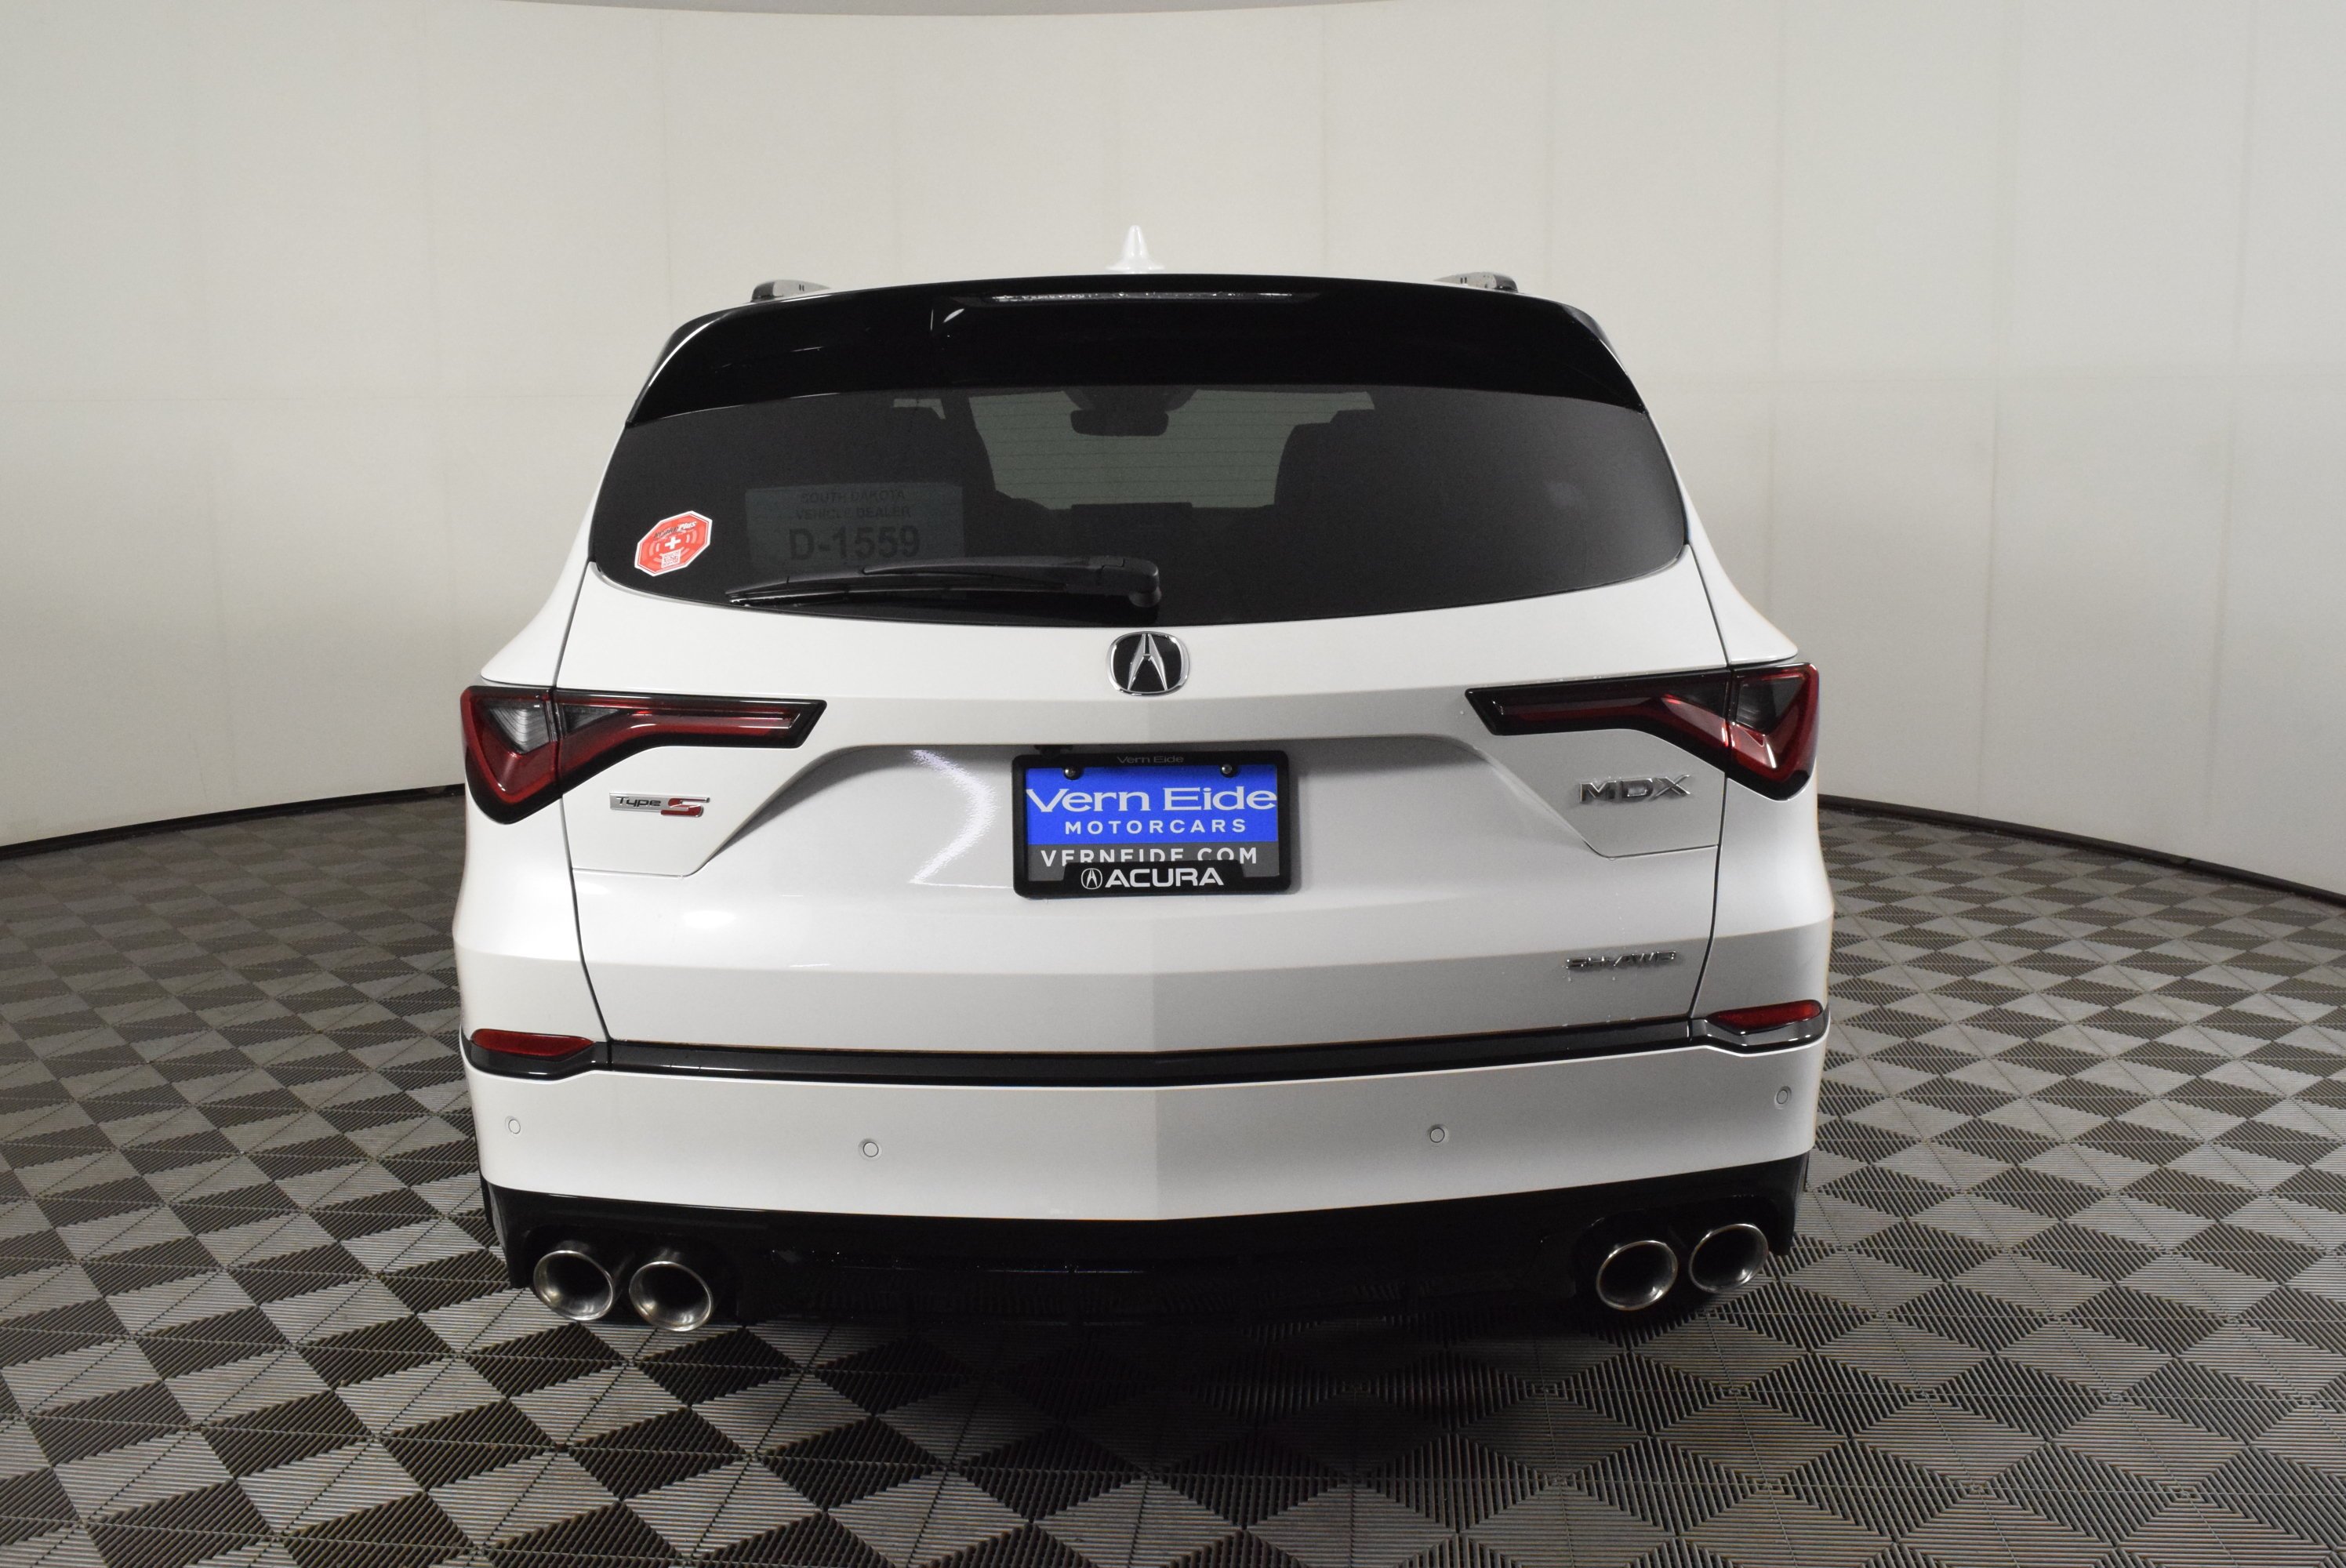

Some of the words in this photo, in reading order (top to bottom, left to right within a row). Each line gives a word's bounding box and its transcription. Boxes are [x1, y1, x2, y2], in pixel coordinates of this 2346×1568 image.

[801, 491, 846, 504] SOUTH
[850, 488, 906, 502] DAKOTA
[855, 506, 911, 519] DEALER
[788, 524, 921, 561] D-1559
[1117, 756, 1150, 764] Vern
[1153, 755, 1185, 764] Eide
[1026, 787, 1152, 813] Vern
[1162, 786, 1277, 811] Eide
[1578, 774, 1691, 804] MDX
[616, 795, 662, 808] Type
[660, 797, 710, 818] S
[1065, 818, 1247, 835] MOTORCARS
[1104, 866, 1225, 888] ACURA
